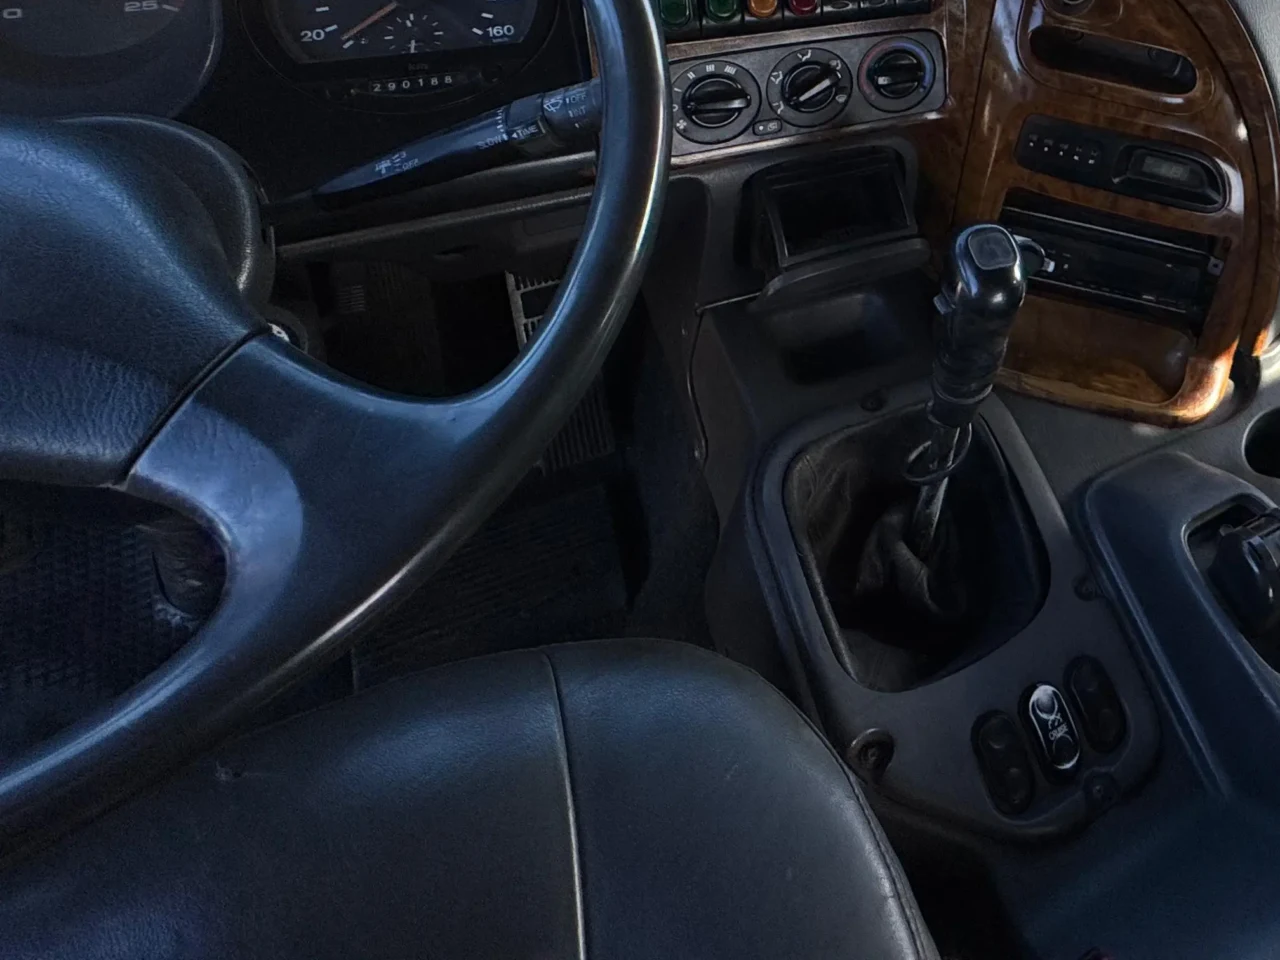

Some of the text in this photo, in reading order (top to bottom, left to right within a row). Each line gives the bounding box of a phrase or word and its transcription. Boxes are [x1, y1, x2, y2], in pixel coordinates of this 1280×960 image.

[124, 0, 158, 12] 25
[2, 8, 22, 19] 0
[301, 30, 325, 41] 20
[486, 25, 514, 37] 160
[516, 124, 539, 139] TIME
